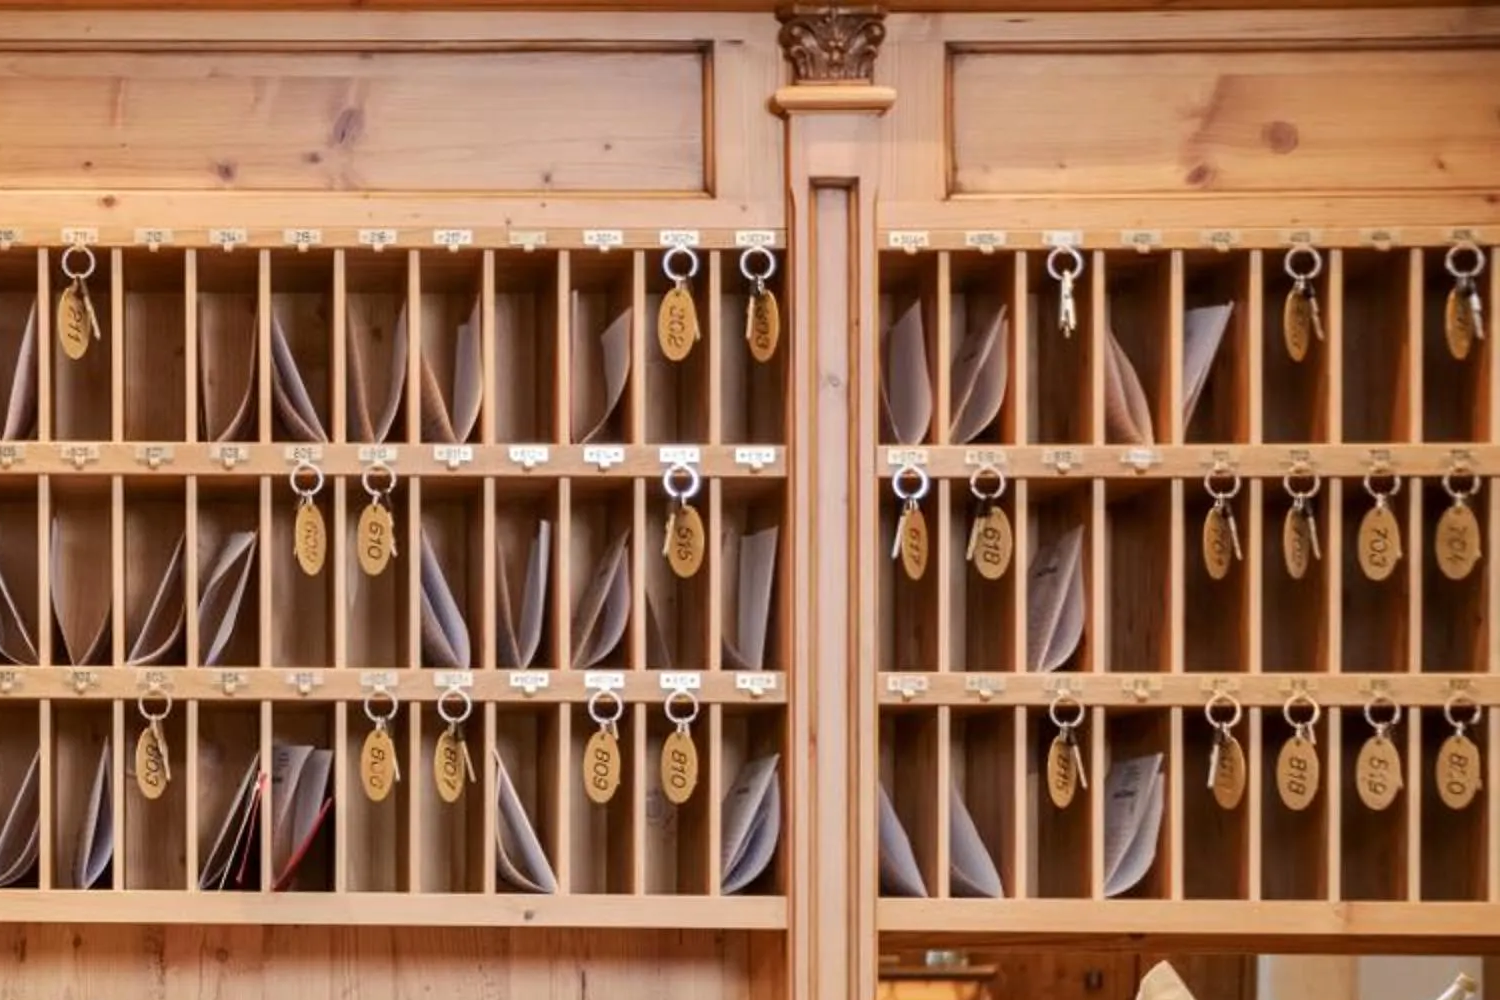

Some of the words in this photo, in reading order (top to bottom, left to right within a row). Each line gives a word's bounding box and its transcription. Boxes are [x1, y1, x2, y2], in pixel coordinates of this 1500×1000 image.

[66, 302, 84, 343] 211
[667, 304, 686, 350] 302
[366, 521, 385, 561] 610
[983, 526, 1002, 566] 618
[1369, 526, 1389, 568] 703
[1446, 524, 1468, 563] 704
[145, 743, 163, 788] 803
[444, 747, 459, 791] 807
[592, 747, 611, 792] 809
[670, 747, 687, 789] 810
[1287, 755, 1308, 797] 818
